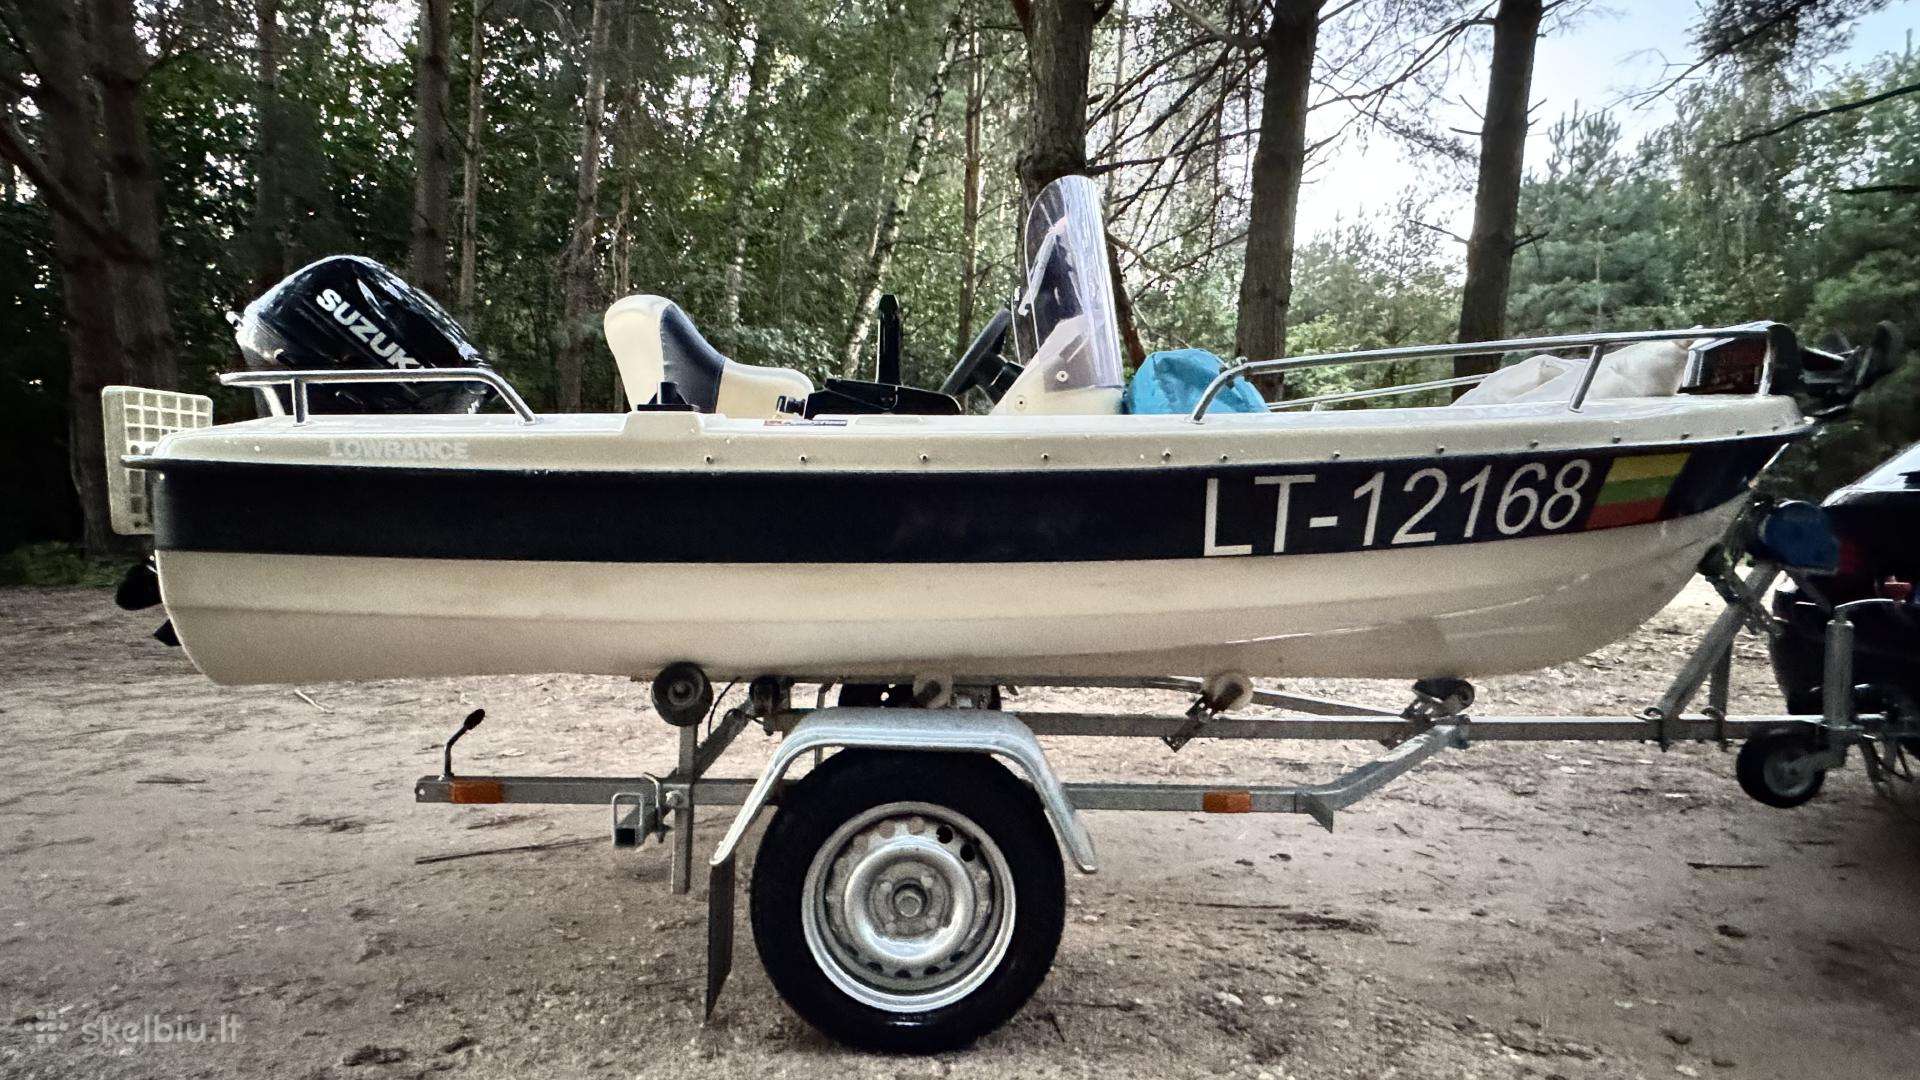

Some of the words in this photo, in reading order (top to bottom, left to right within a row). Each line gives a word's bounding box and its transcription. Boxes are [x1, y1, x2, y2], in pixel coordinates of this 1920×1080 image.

[316, 288, 426, 369] SUZUK
[329, 440, 469, 460] LOWRANCE
[1203, 459, 1592, 557] LT-12168
